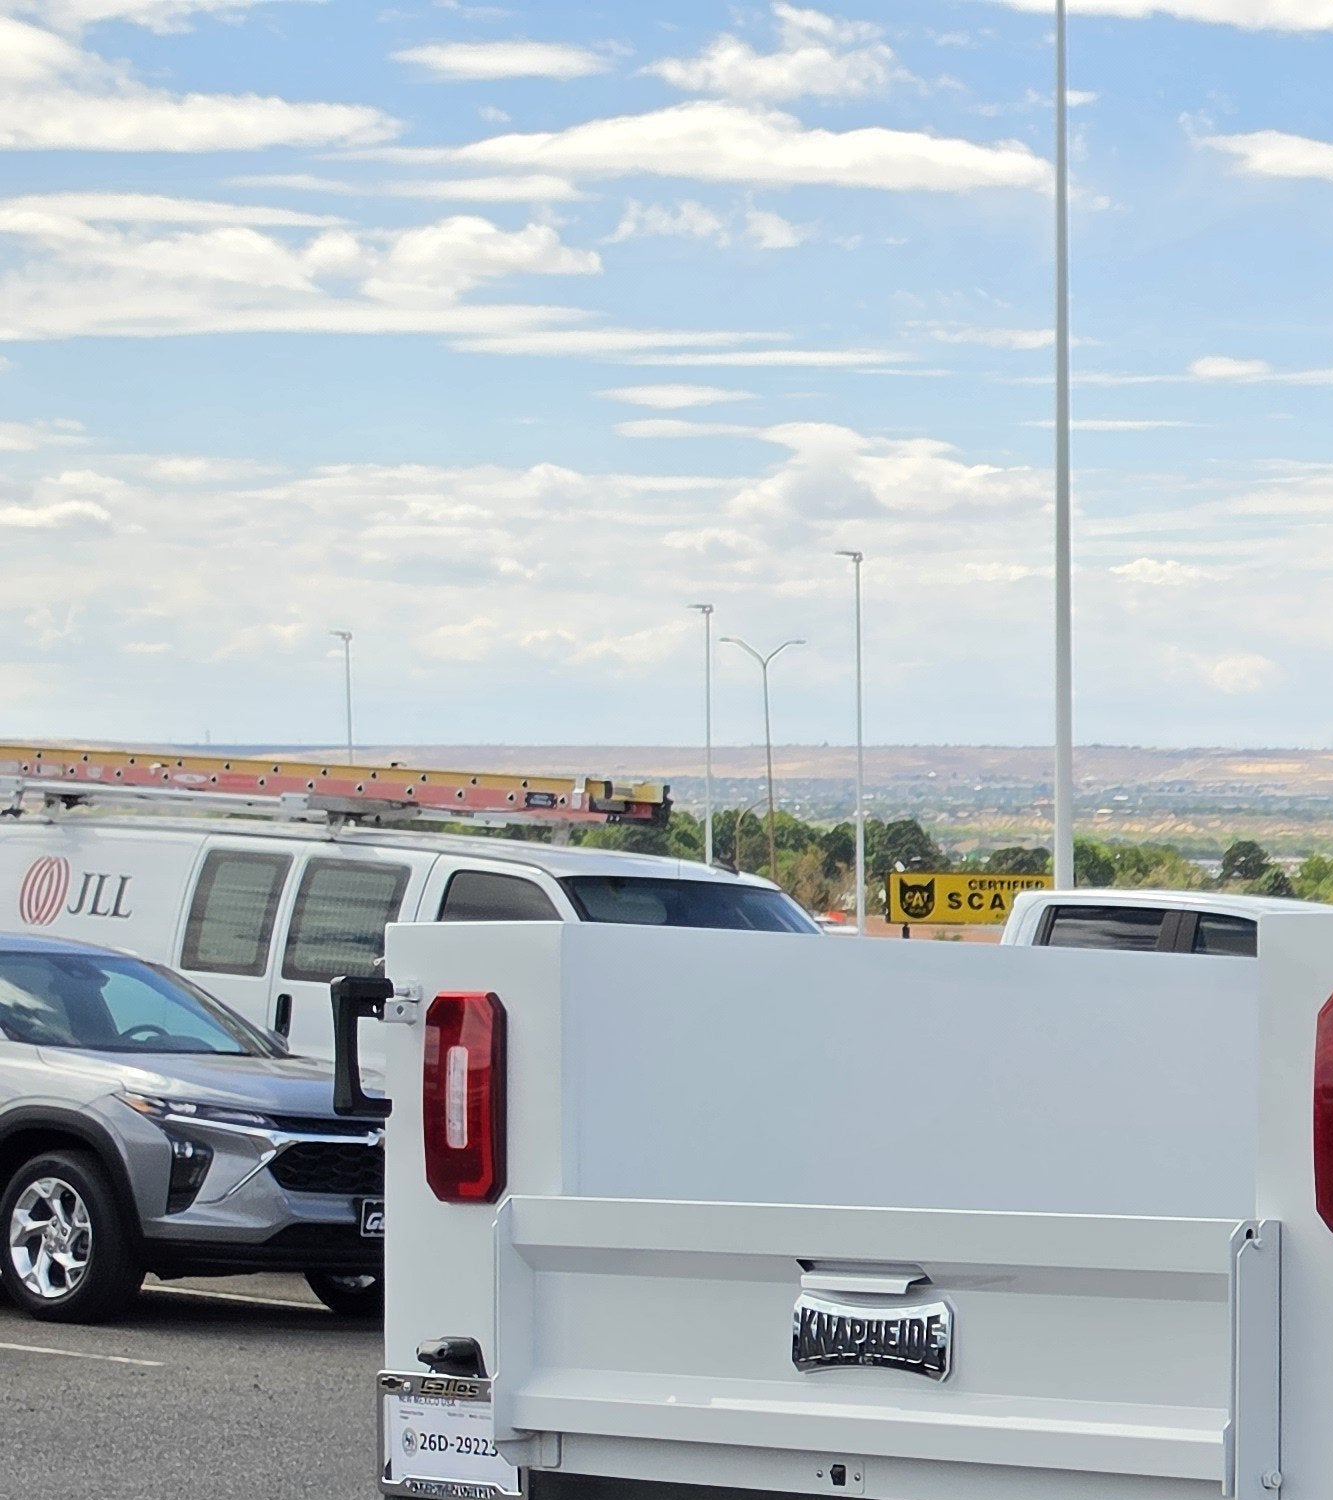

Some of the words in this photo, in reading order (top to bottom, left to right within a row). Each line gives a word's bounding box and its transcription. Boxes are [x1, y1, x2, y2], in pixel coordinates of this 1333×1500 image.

[66, 871, 133, 918] JLL
[947, 892, 1006, 911] SCA
[800, 1305, 943, 1370] KNAPHEIDE
